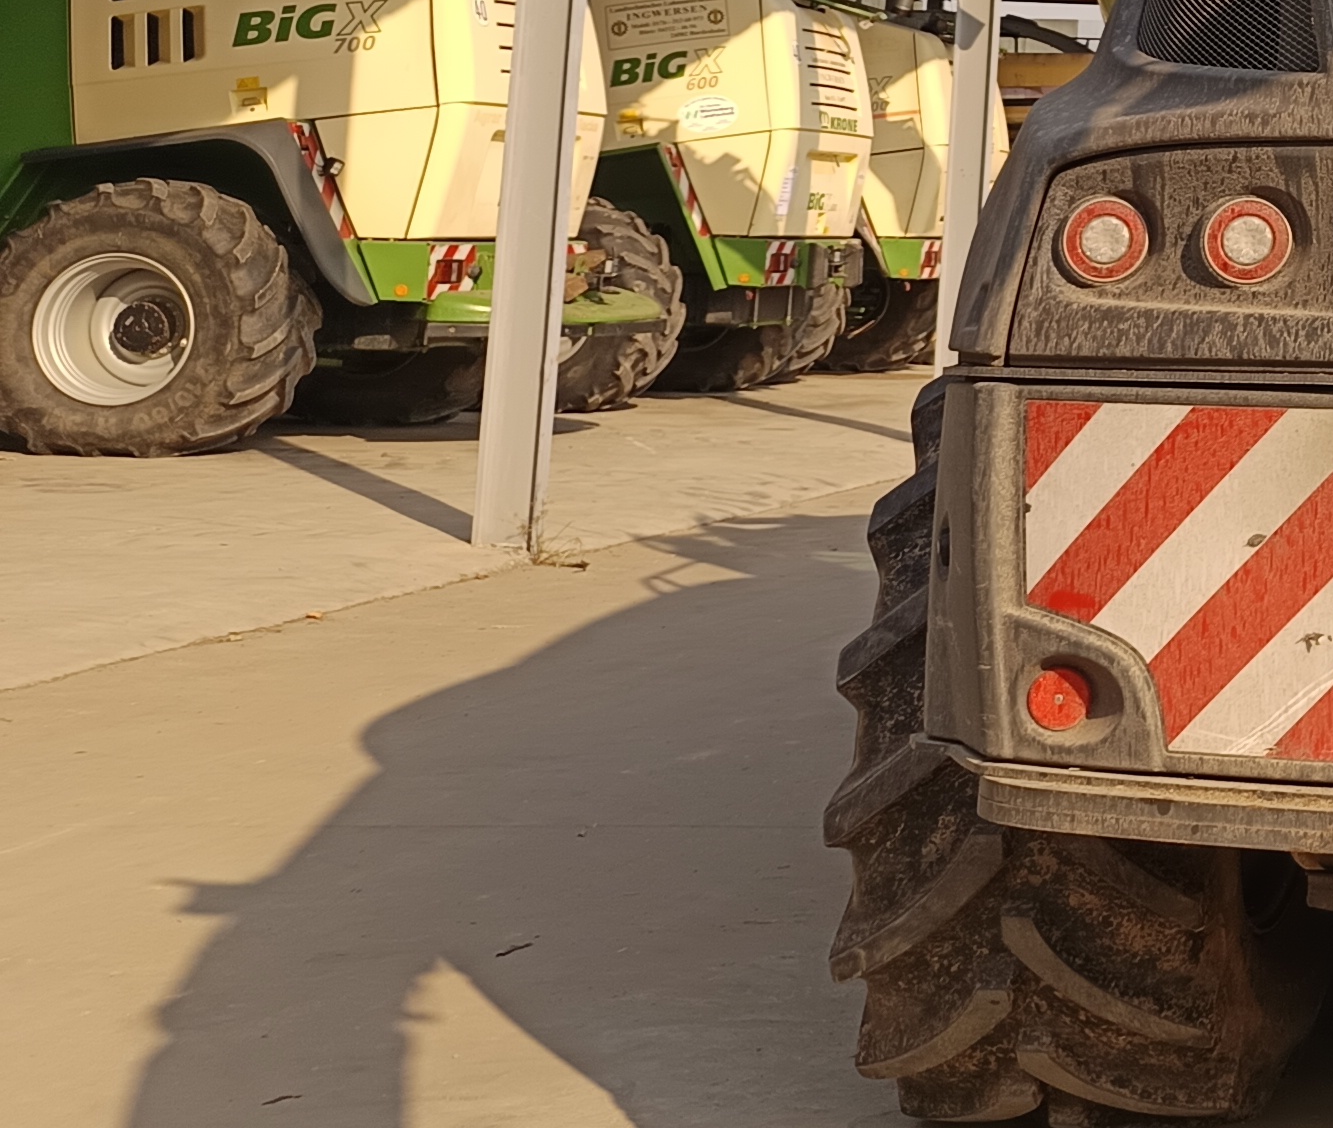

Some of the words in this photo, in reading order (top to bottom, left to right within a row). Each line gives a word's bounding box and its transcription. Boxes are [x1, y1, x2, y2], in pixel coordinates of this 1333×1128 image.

[626, 5, 708, 21] INGWERSEN
[333, 35, 376, 54] 700
[686, 75, 719, 91] 600
[830, 116, 858, 133] KRONE
